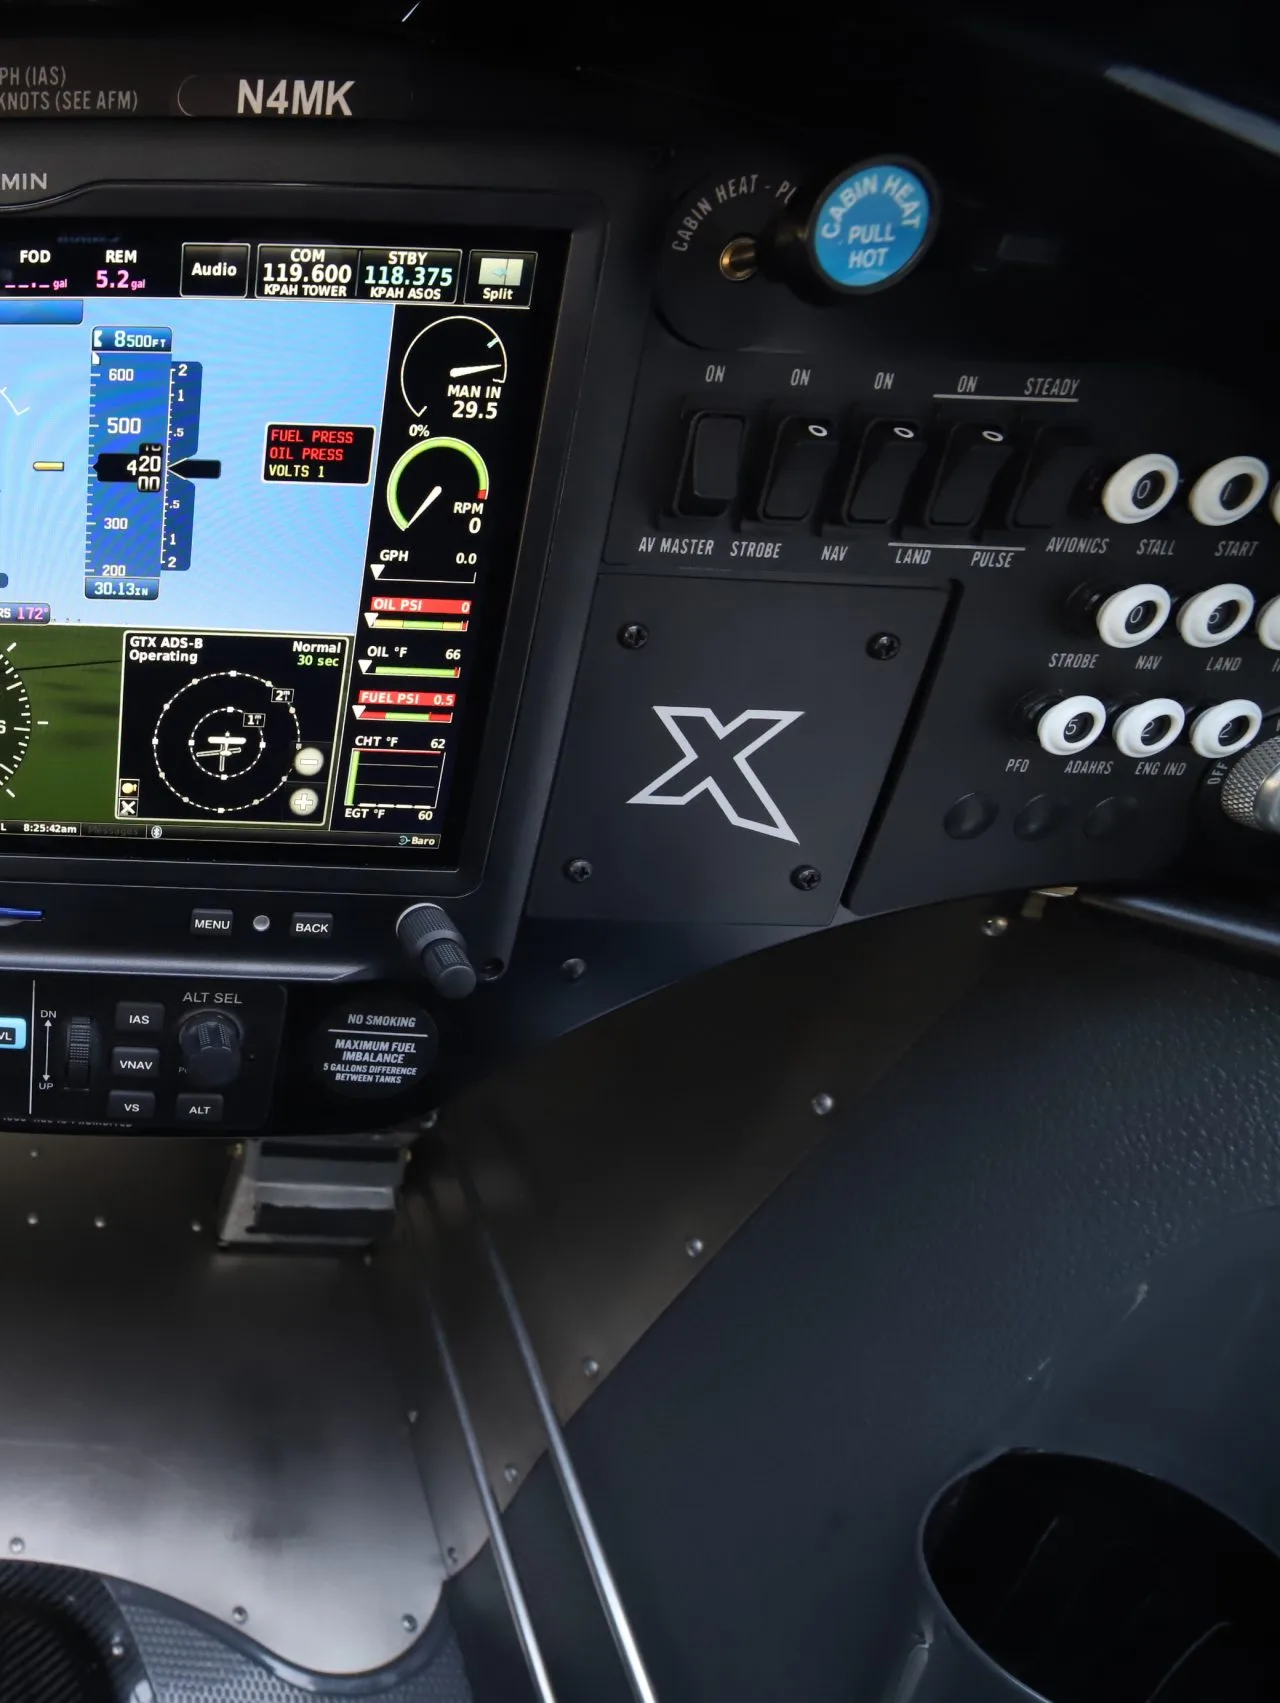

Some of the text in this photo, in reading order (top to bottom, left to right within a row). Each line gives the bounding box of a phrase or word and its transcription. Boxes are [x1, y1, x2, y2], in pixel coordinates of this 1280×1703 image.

[25, 66, 67, 88] (IAS)
[55, 90, 91, 112] (SEE
[96, 90, 138, 112] AFM)
[237, 78, 356, 116] N4MK
[672, 197, 714, 252] CABIN
[715, 173, 759, 204] HEAT
[821, 174, 921, 240] CABIN HEAT
[848, 223, 896, 245] PULL
[20, 250, 51, 263] FOD
[105, 250, 137, 263] REM
[290, 248, 325, 263] COM
[388, 250, 428, 266] STBY
[848, 247, 889, 269] HOT
[191, 262, 237, 276] Audio
[262, 263, 352, 284] 119.600
[364, 265, 453, 287] 118.375
[264, 284, 347, 297] KPAH TOWER
[370, 287, 441, 300] KPAH ASOS
[482, 287, 513, 302] Split
[705, 365, 725, 383] ON
[447, 384, 501, 399] MAN IN
[957, 375, 978, 393] ON
[1023, 378, 1080, 397] STEADY
[452, 400, 498, 420] 29.5
[271, 429, 354, 444] FUEL PRESS
[269, 447, 344, 461] OIL PRESS
[269, 464, 309, 477] VOLTS
[453, 501, 484, 514] RPM
[638, 537, 715, 556] AV MASTER
[729, 541, 782, 559] STROBE
[1046, 536, 1110, 554] AVIONICS
[1136, 539, 1175, 555] STALL
[1215, 541, 1259, 557] START
[379, 550, 409, 562] GPH
[820, 545, 848, 562] NAV
[895, 549, 931, 566] LAND
[970, 551, 1013, 568] PULSE
[373, 598, 422, 611] OIL PSI
[129, 636, 203, 649] GTX ADS-B
[293, 641, 341, 653] Normal
[129, 650, 198, 665] Operating
[297, 655, 339, 667] 30 sec
[1048, 653, 1099, 668] STROBE
[1135, 655, 1163, 670] NAV
[1205, 656, 1243, 671] LAND
[361, 692, 419, 705] FUEL PSI
[1005, 759, 1030, 773] PFD
[1064, 760, 1114, 775] ADAHRS
[1134, 761, 1187, 777] ENG IND
[23, 823, 77, 833] 8:25:42am
[411, 836, 435, 846] Baro
[194, 919, 230, 930] MENU
[295, 922, 329, 933] BACK
[182, 992, 243, 1004] ALT SEL
[129, 1015, 149, 1025] IAS
[347, 1013, 416, 1028] NO SMOKING
[335, 1039, 417, 1053] MAXIMUM FUEL
[119, 1060, 153, 1070] VNAV
[342, 1051, 405, 1064] IMBALANCE
[323, 1063, 417, 1075] 5 GALLONS DIFFERENCE
[335, 1073, 402, 1084] BETWEEN TANKS
[124, 1103, 140, 1113] VS
[189, 1105, 211, 1115] ALT
